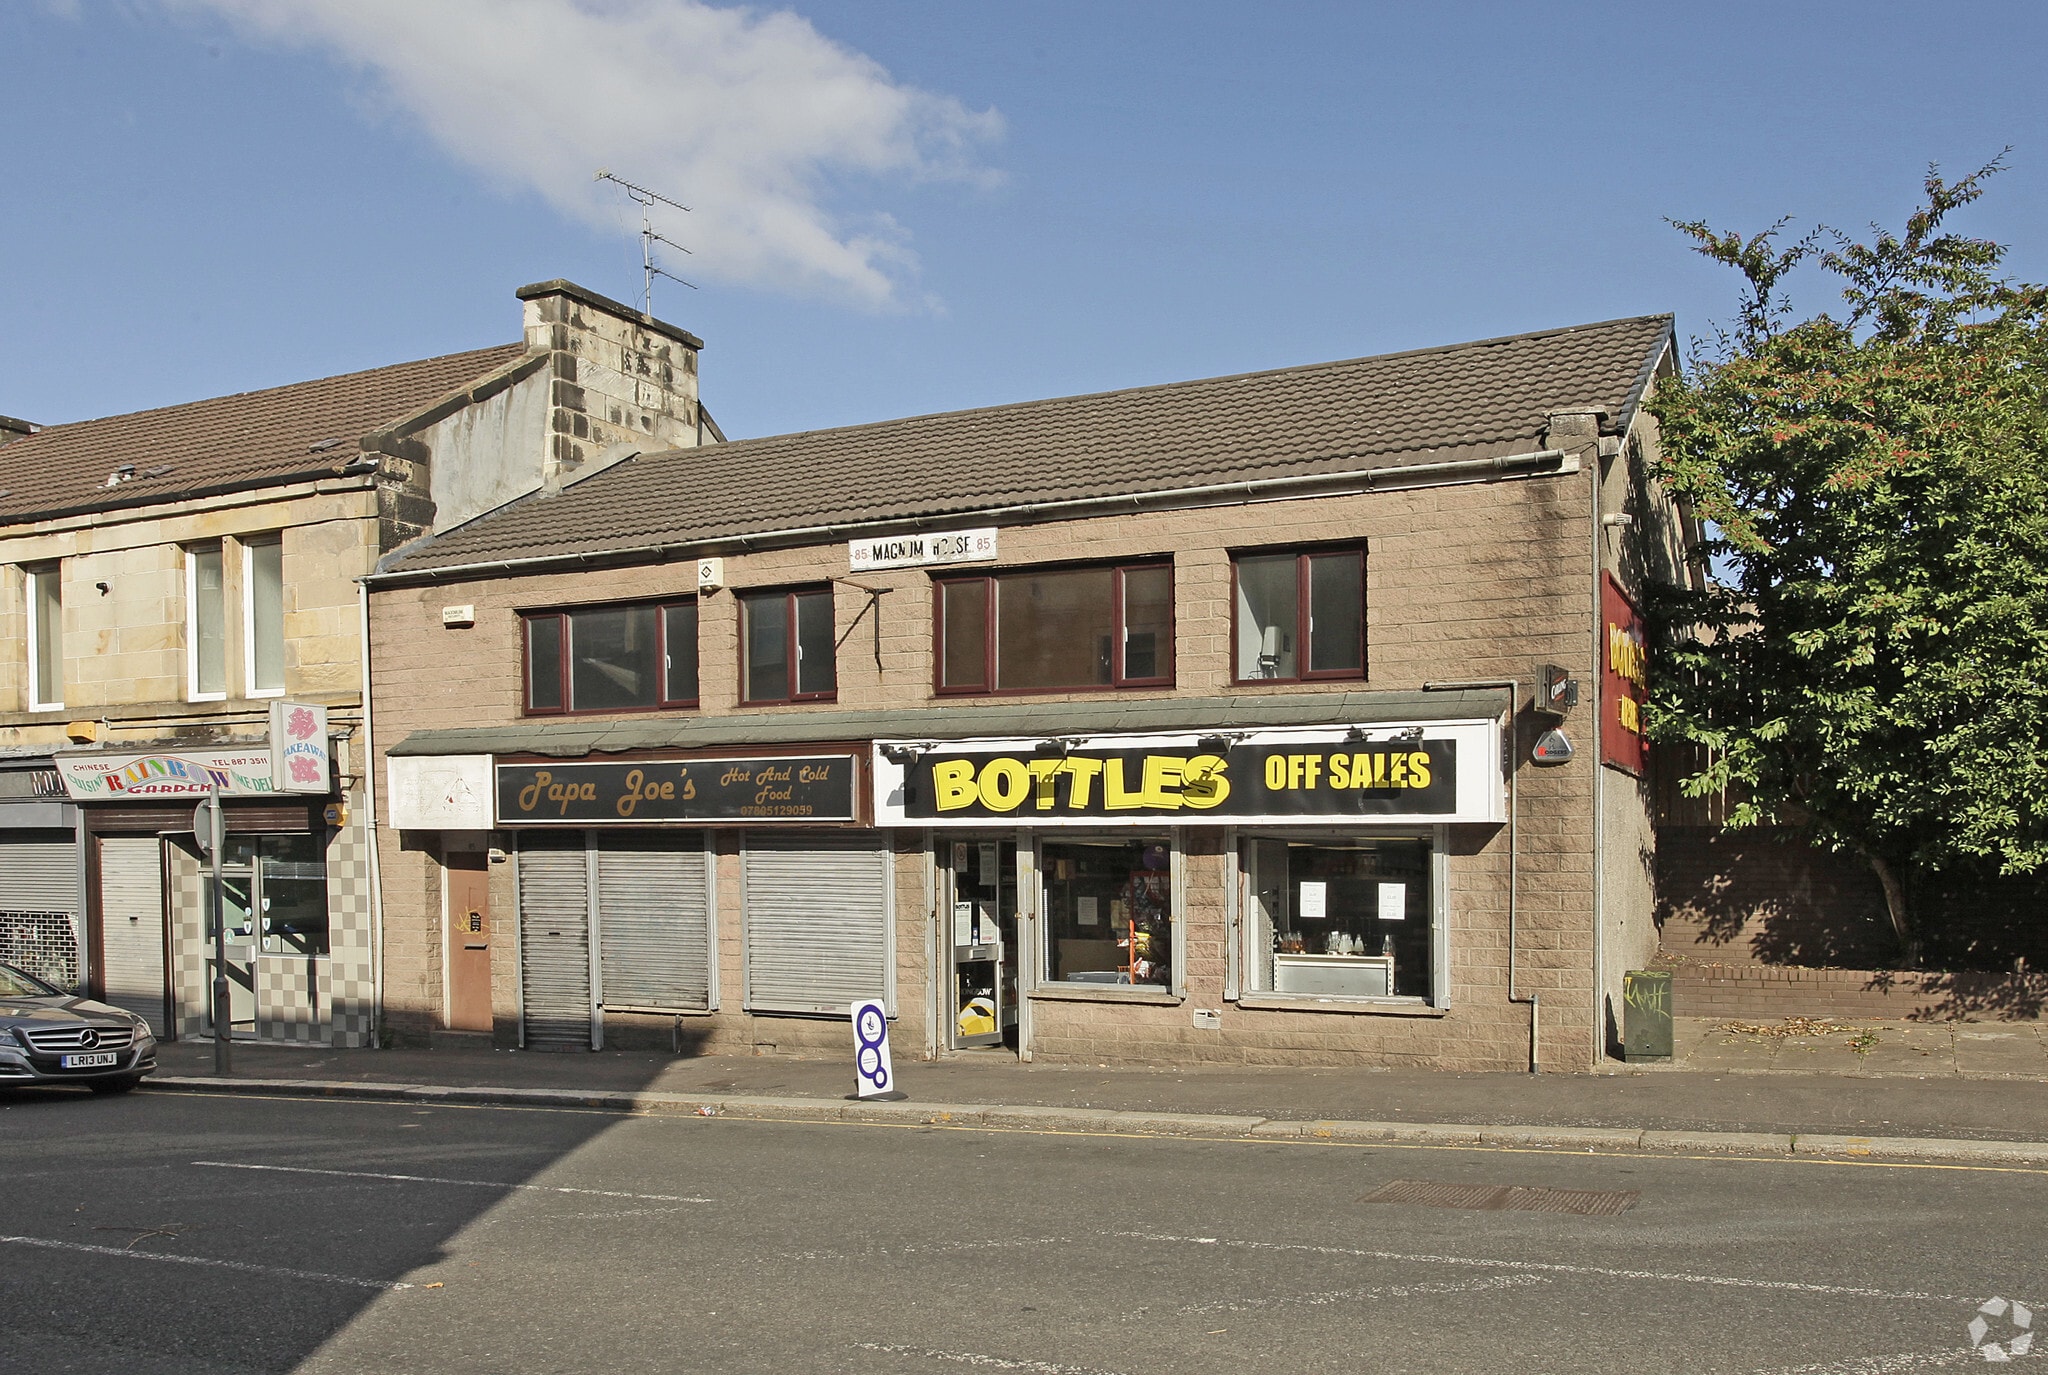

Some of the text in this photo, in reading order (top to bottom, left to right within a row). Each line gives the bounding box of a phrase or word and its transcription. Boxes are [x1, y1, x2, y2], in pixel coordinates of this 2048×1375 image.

[854, 549, 867, 560] 85
[933, 536, 970, 556] HSE
[976, 538, 991, 550] 85
[73, 763, 111, 772] CHINESE
[231, 758, 247, 766] 887
[250, 757, 268, 765] 3511
[1265, 751, 1431, 790] OFF SALES
[105, 759, 230, 792] RAINBOW
[720, 765, 830, 787] Hot And Cold
[932, 754, 1231, 812] BOTTLES
[128, 783, 212, 794] GARDEN
[519, 768, 697, 817] Papa Joe's
[755, 785, 793, 805] Food
[71, 1054, 114, 1066] LR13 UNJ
